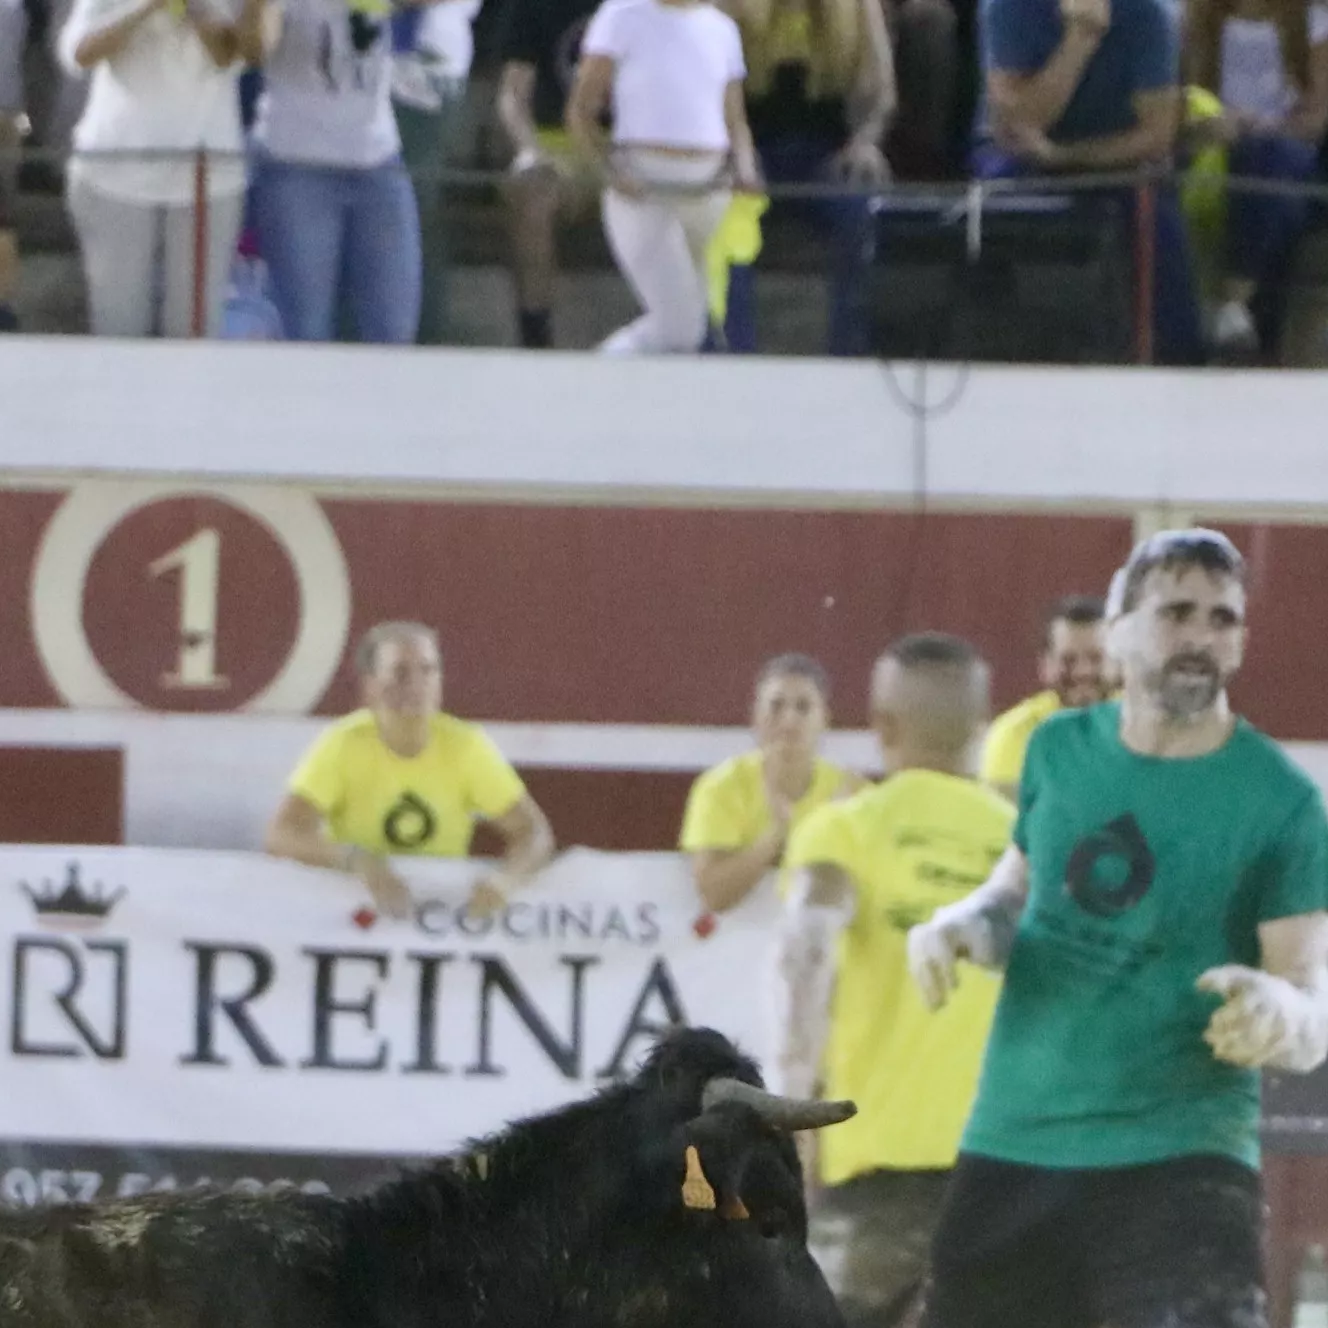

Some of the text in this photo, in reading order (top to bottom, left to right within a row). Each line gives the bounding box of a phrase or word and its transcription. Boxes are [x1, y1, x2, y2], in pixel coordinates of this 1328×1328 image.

[147, 527, 231, 690] 1
[414, 898, 662, 944] COCINAS
[179, 939, 690, 1082] REINA
